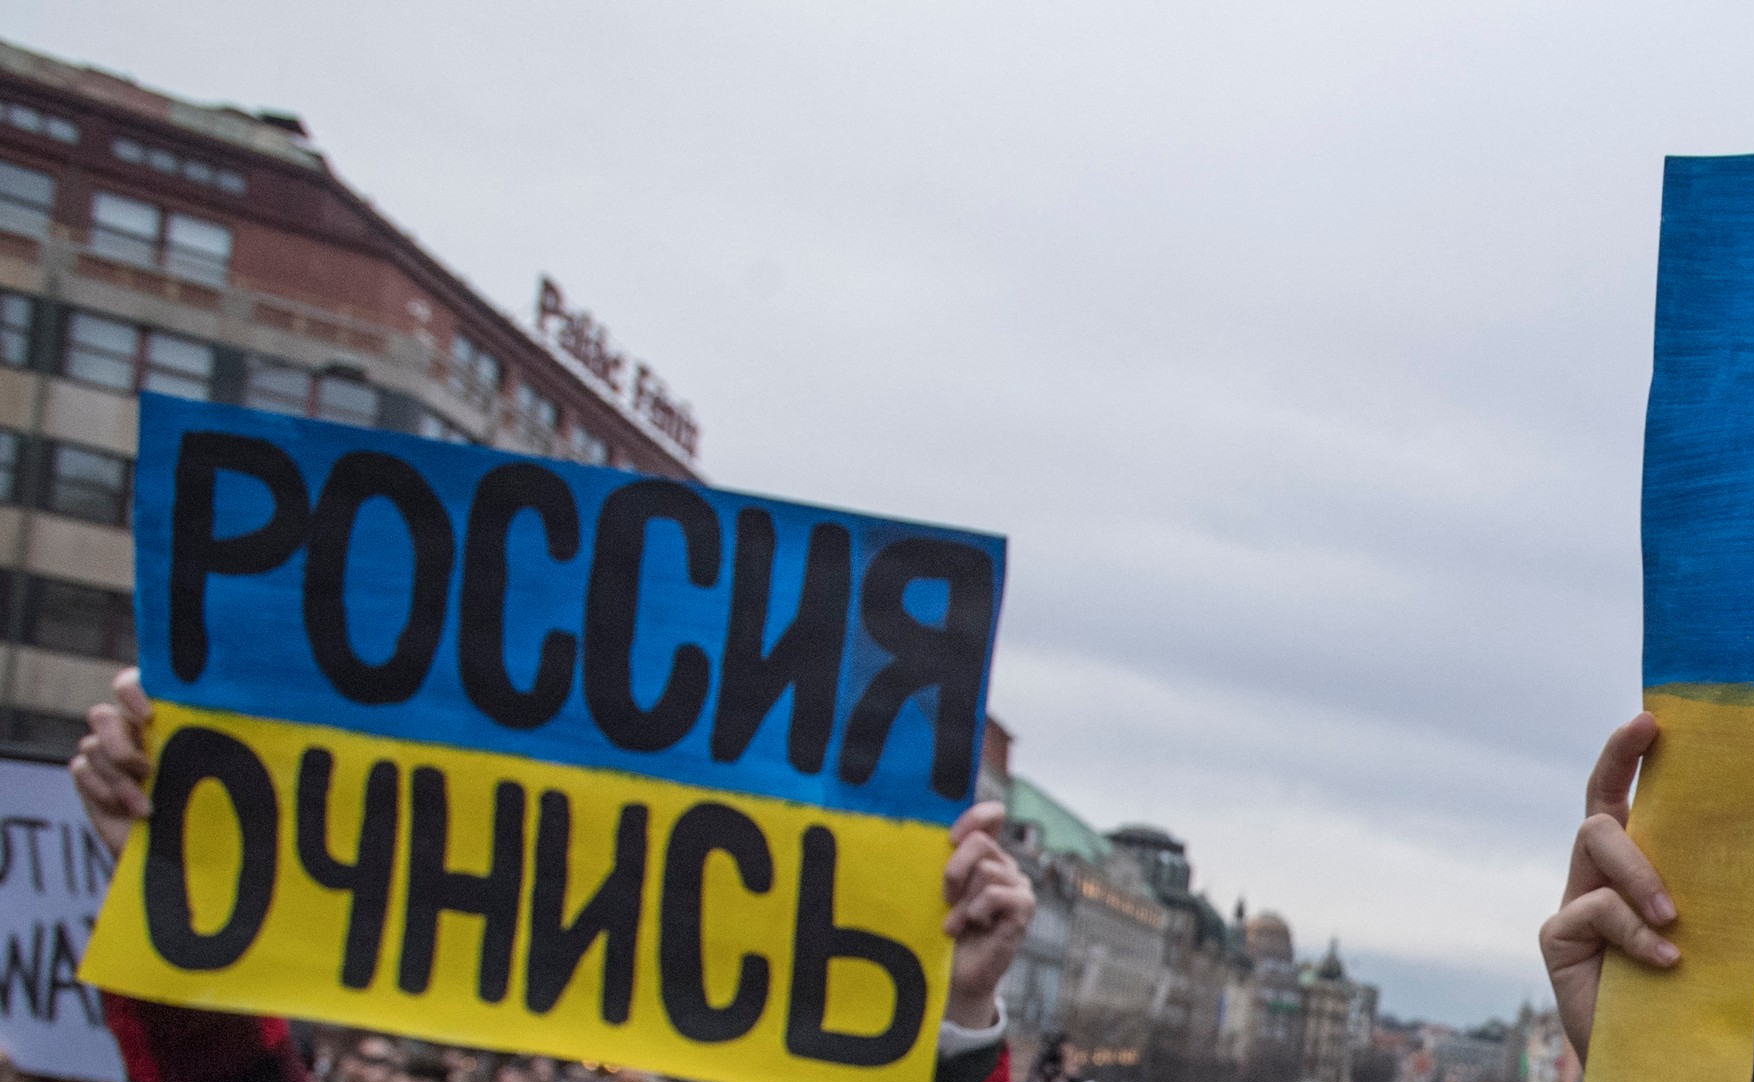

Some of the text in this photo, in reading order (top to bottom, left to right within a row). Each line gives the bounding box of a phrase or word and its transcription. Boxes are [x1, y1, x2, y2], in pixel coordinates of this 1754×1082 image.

[169, 430, 996, 801] РОССИЯ
[0, 914, 103, 1030] WA
[143, 725, 929, 1067] ОЧНИСЬ
